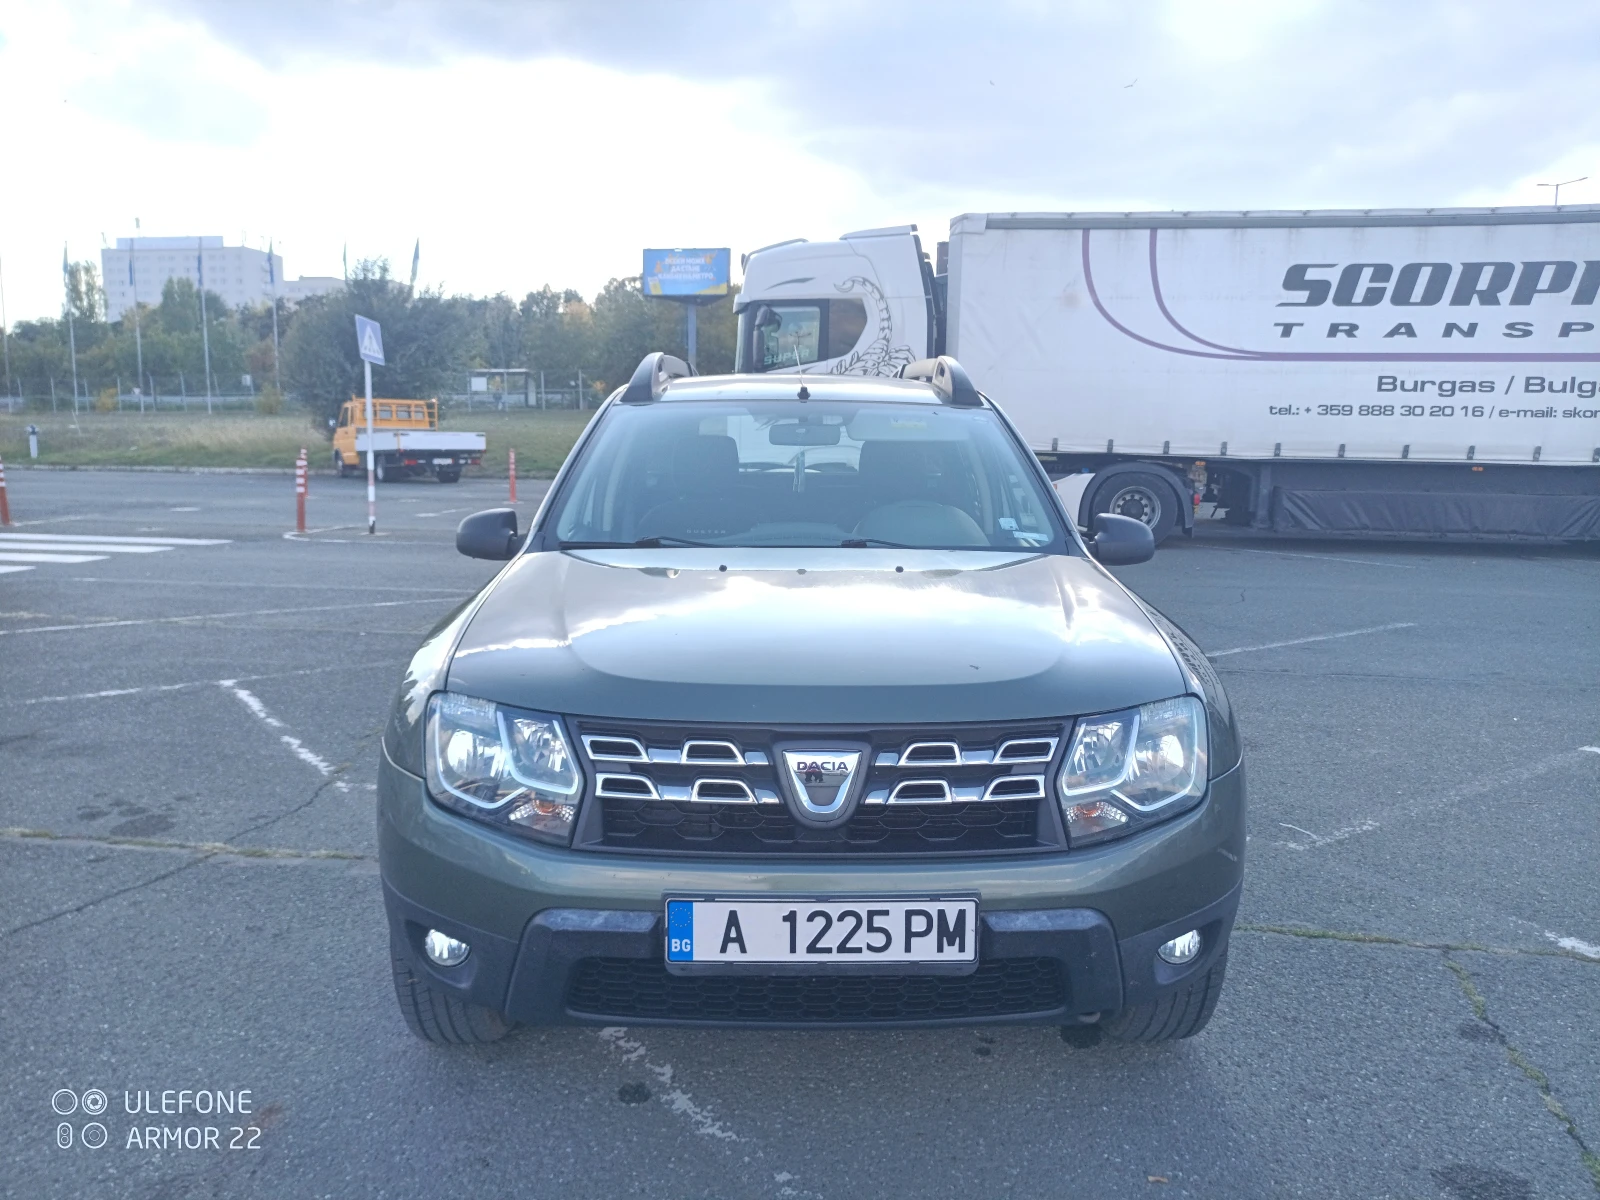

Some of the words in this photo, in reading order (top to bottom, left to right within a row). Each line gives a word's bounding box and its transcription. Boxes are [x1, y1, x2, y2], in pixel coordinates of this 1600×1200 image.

[1275, 260, 1600, 307] SCORPI
[1273, 322, 1595, 338] TRANSP
[1377, 375, 1495, 398] Burgas
[1504, 375, 1515, 395] /
[1524, 376, 1600, 398] Bulg
[1317, 404, 1353, 416] 359
[1358, 405, 1394, 416] 888
[1400, 405, 1425, 417] 30
[1429, 405, 1454, 417] 20
[1460, 405, 1484, 418] 16
[1498, 406, 1557, 418] e-mail:
[797, 761, 848, 771] DACIA
[719, 909, 747, 954] A
[782, 909, 892, 954] 1225
[904, 908, 966, 954] PM
[671, 939, 691, 952] BG
